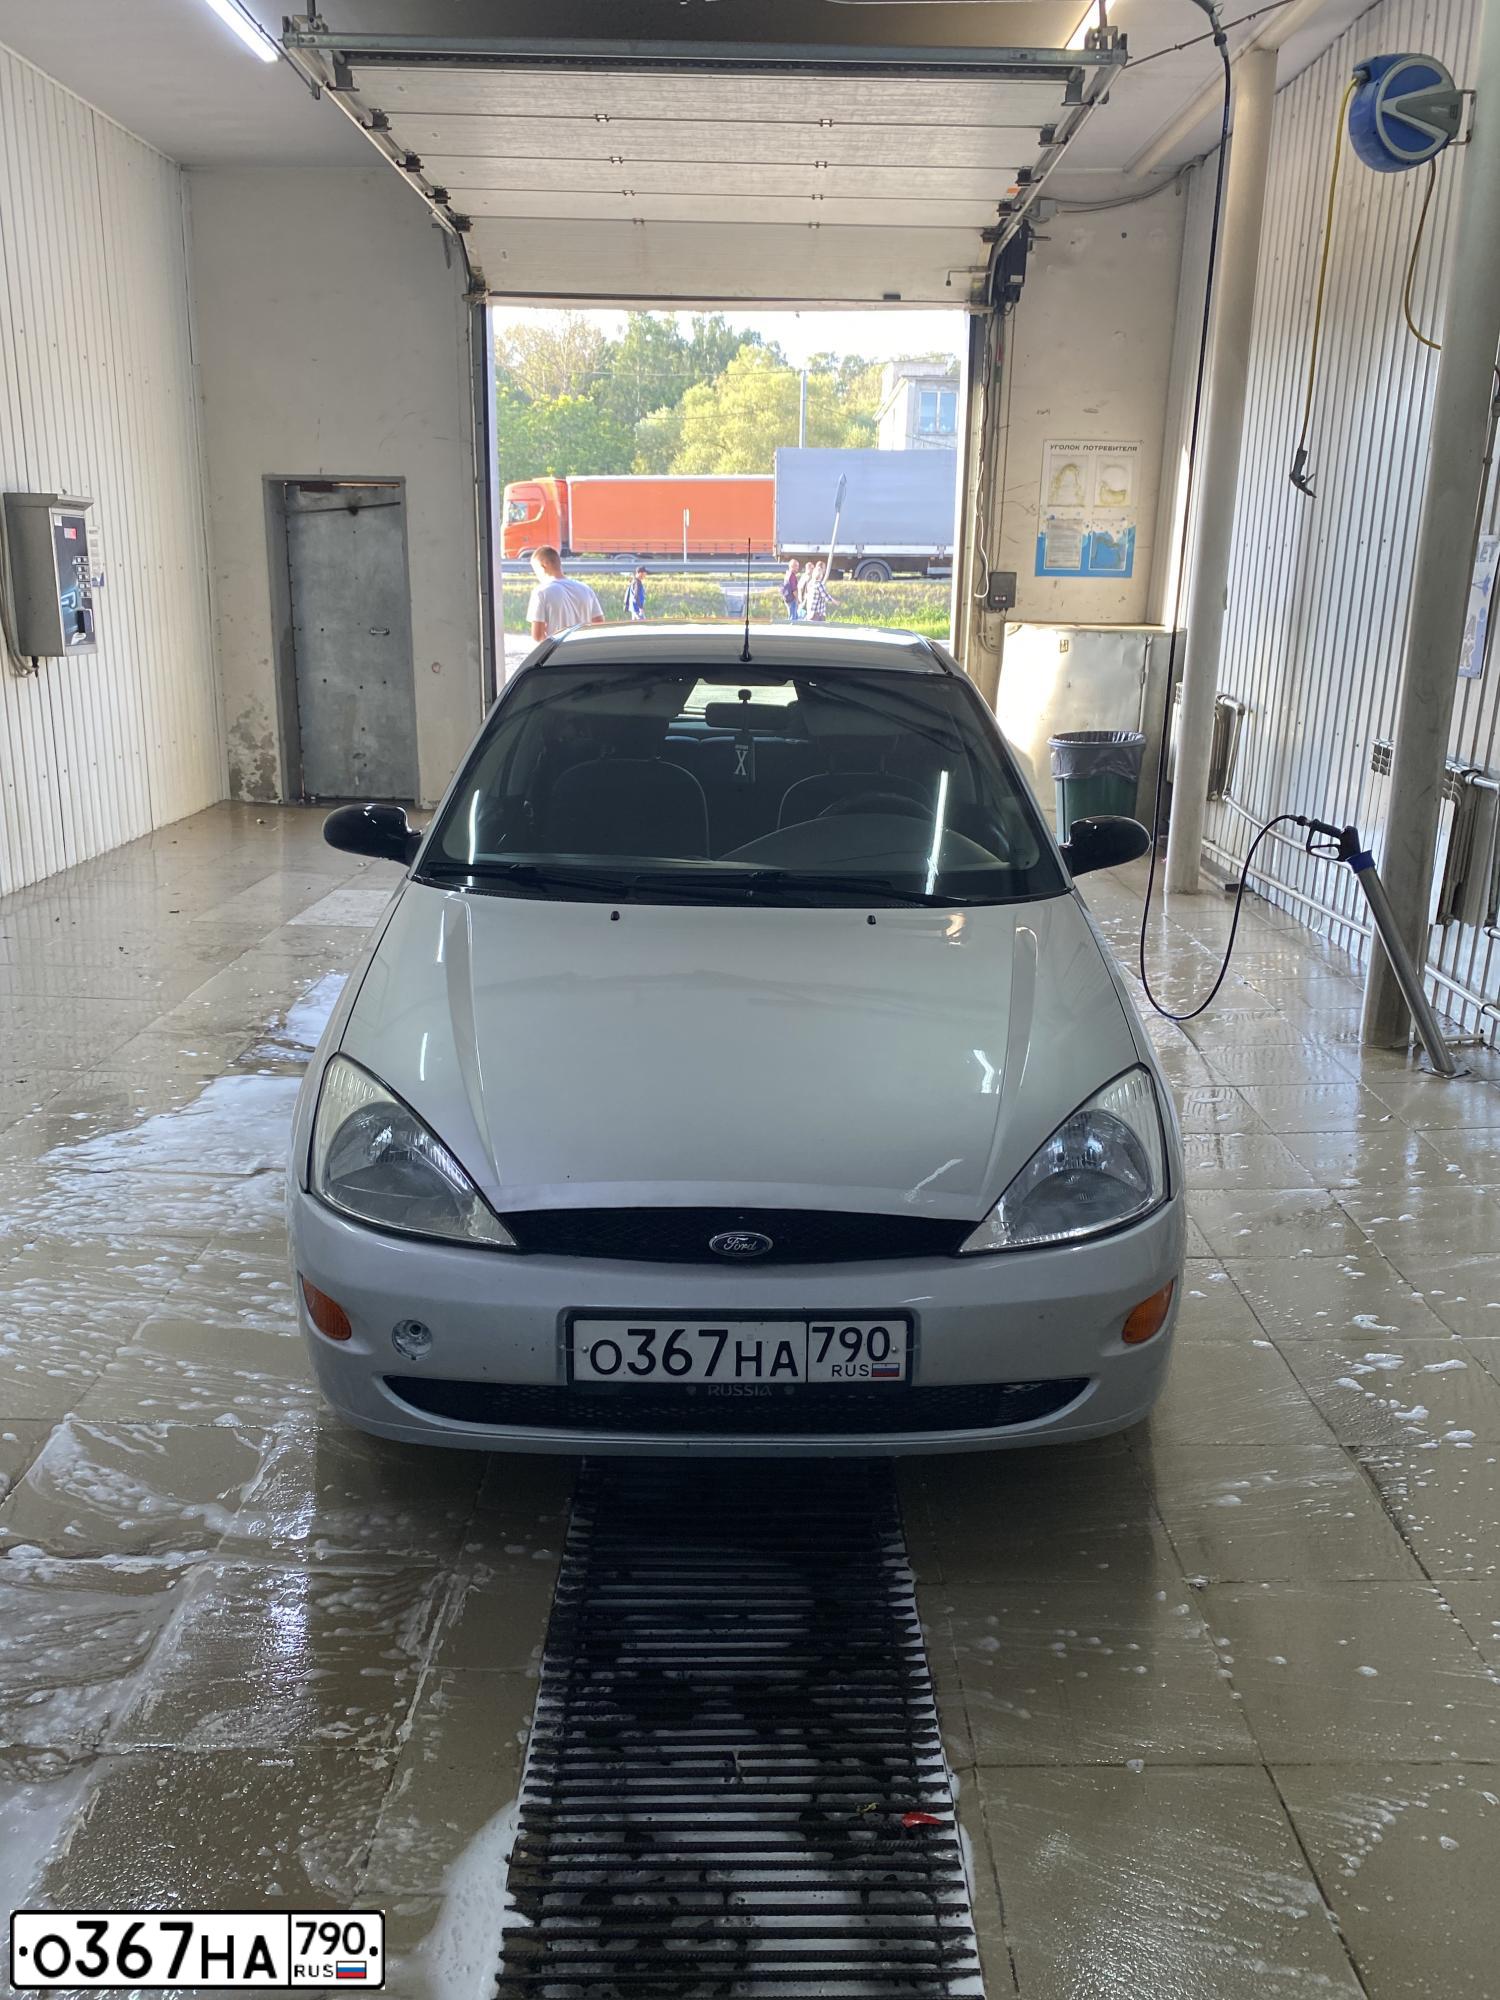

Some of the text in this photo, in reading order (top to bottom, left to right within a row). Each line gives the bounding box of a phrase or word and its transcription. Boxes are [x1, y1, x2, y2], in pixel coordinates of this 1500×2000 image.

[723, 1237, 757, 1250] Ford
[811, 1326, 891, 1363] 790
[831, 1364, 870, 1378] RUS
[707, 1383, 773, 1397] RUSSIA
